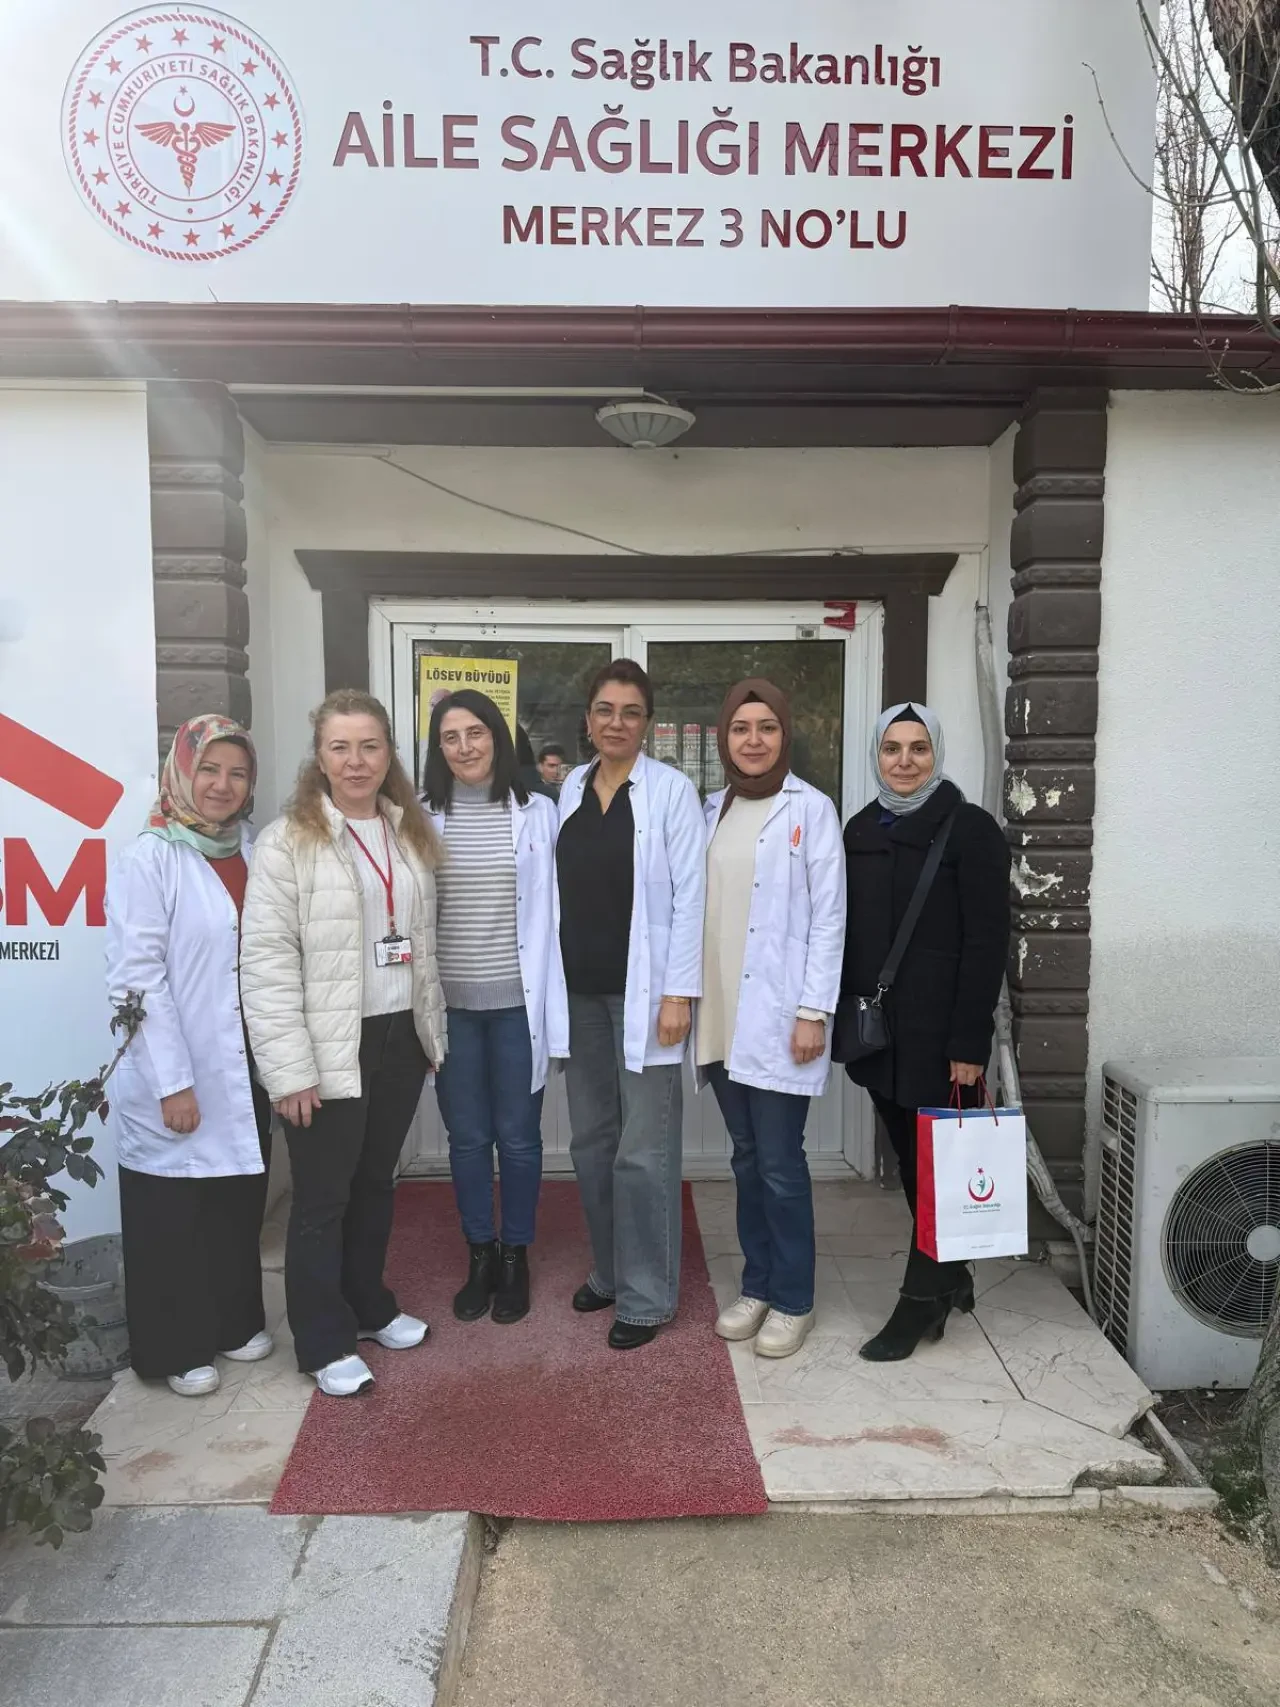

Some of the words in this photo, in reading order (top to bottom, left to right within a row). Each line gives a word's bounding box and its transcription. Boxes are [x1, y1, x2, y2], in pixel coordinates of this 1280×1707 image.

[199, 64, 250, 111] SAĞLIK
[470, 35, 554, 78] T.C.
[570, 38, 713, 90] Sağlık
[729, 42, 941, 96] Bakanlığı
[113, 58, 193, 135] CUMHURİYETİ
[224, 114, 259, 203] BAKANLIĞI
[332, 100, 480, 169] AİLE
[500, 103, 759, 175] SAĞLIĞI
[785, 114, 1074, 179] MERKEZİ
[503, 205, 705, 247] MERKEZ
[719, 208, 744, 248] 3
[761, 208, 907, 249] NO’LU
[426, 667, 462, 681] LÖSEV
[465, 669, 511, 684] BÜYÜDÜ
[0, 939, 60, 960] MERKEZİ
